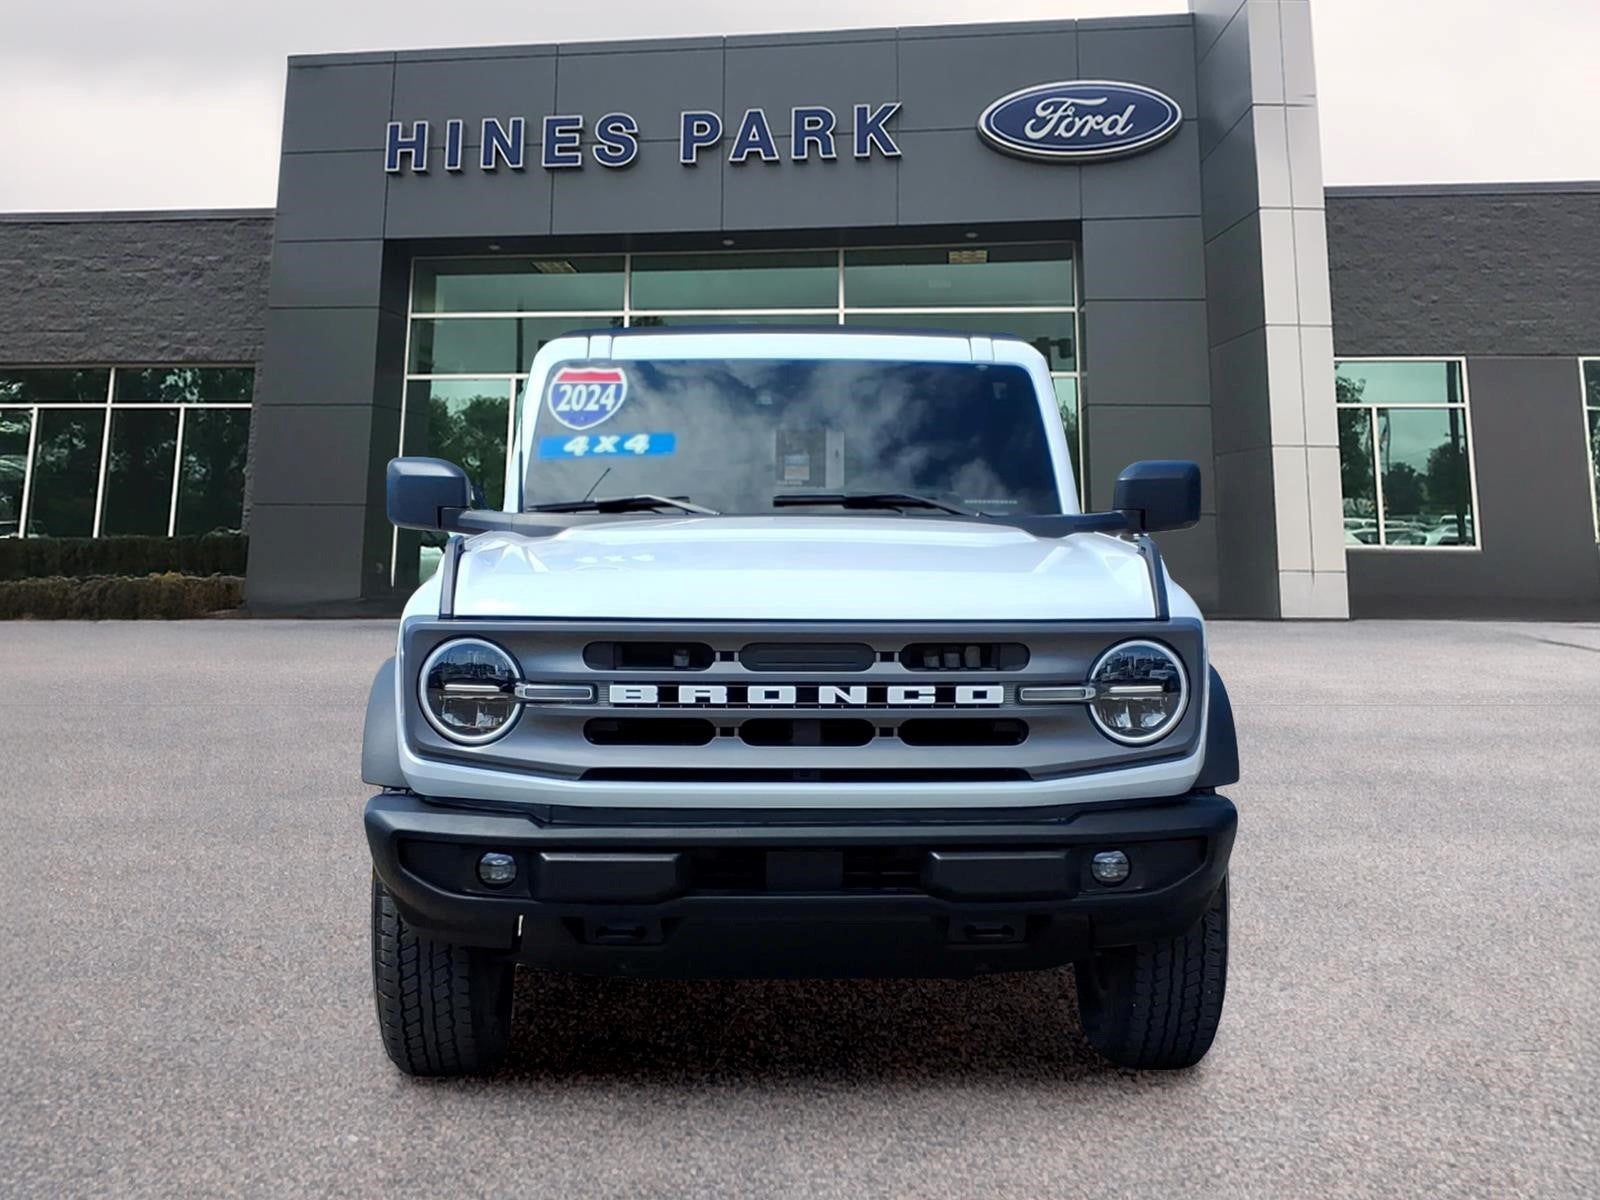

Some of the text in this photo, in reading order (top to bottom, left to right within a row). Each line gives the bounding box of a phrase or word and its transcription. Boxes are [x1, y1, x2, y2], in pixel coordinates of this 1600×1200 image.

[1024, 97, 1136, 139] Ford
[385, 102, 902, 172] HINES PARK
[556, 384, 616, 412] 2024
[609, 685, 1004, 704] BRONCO
